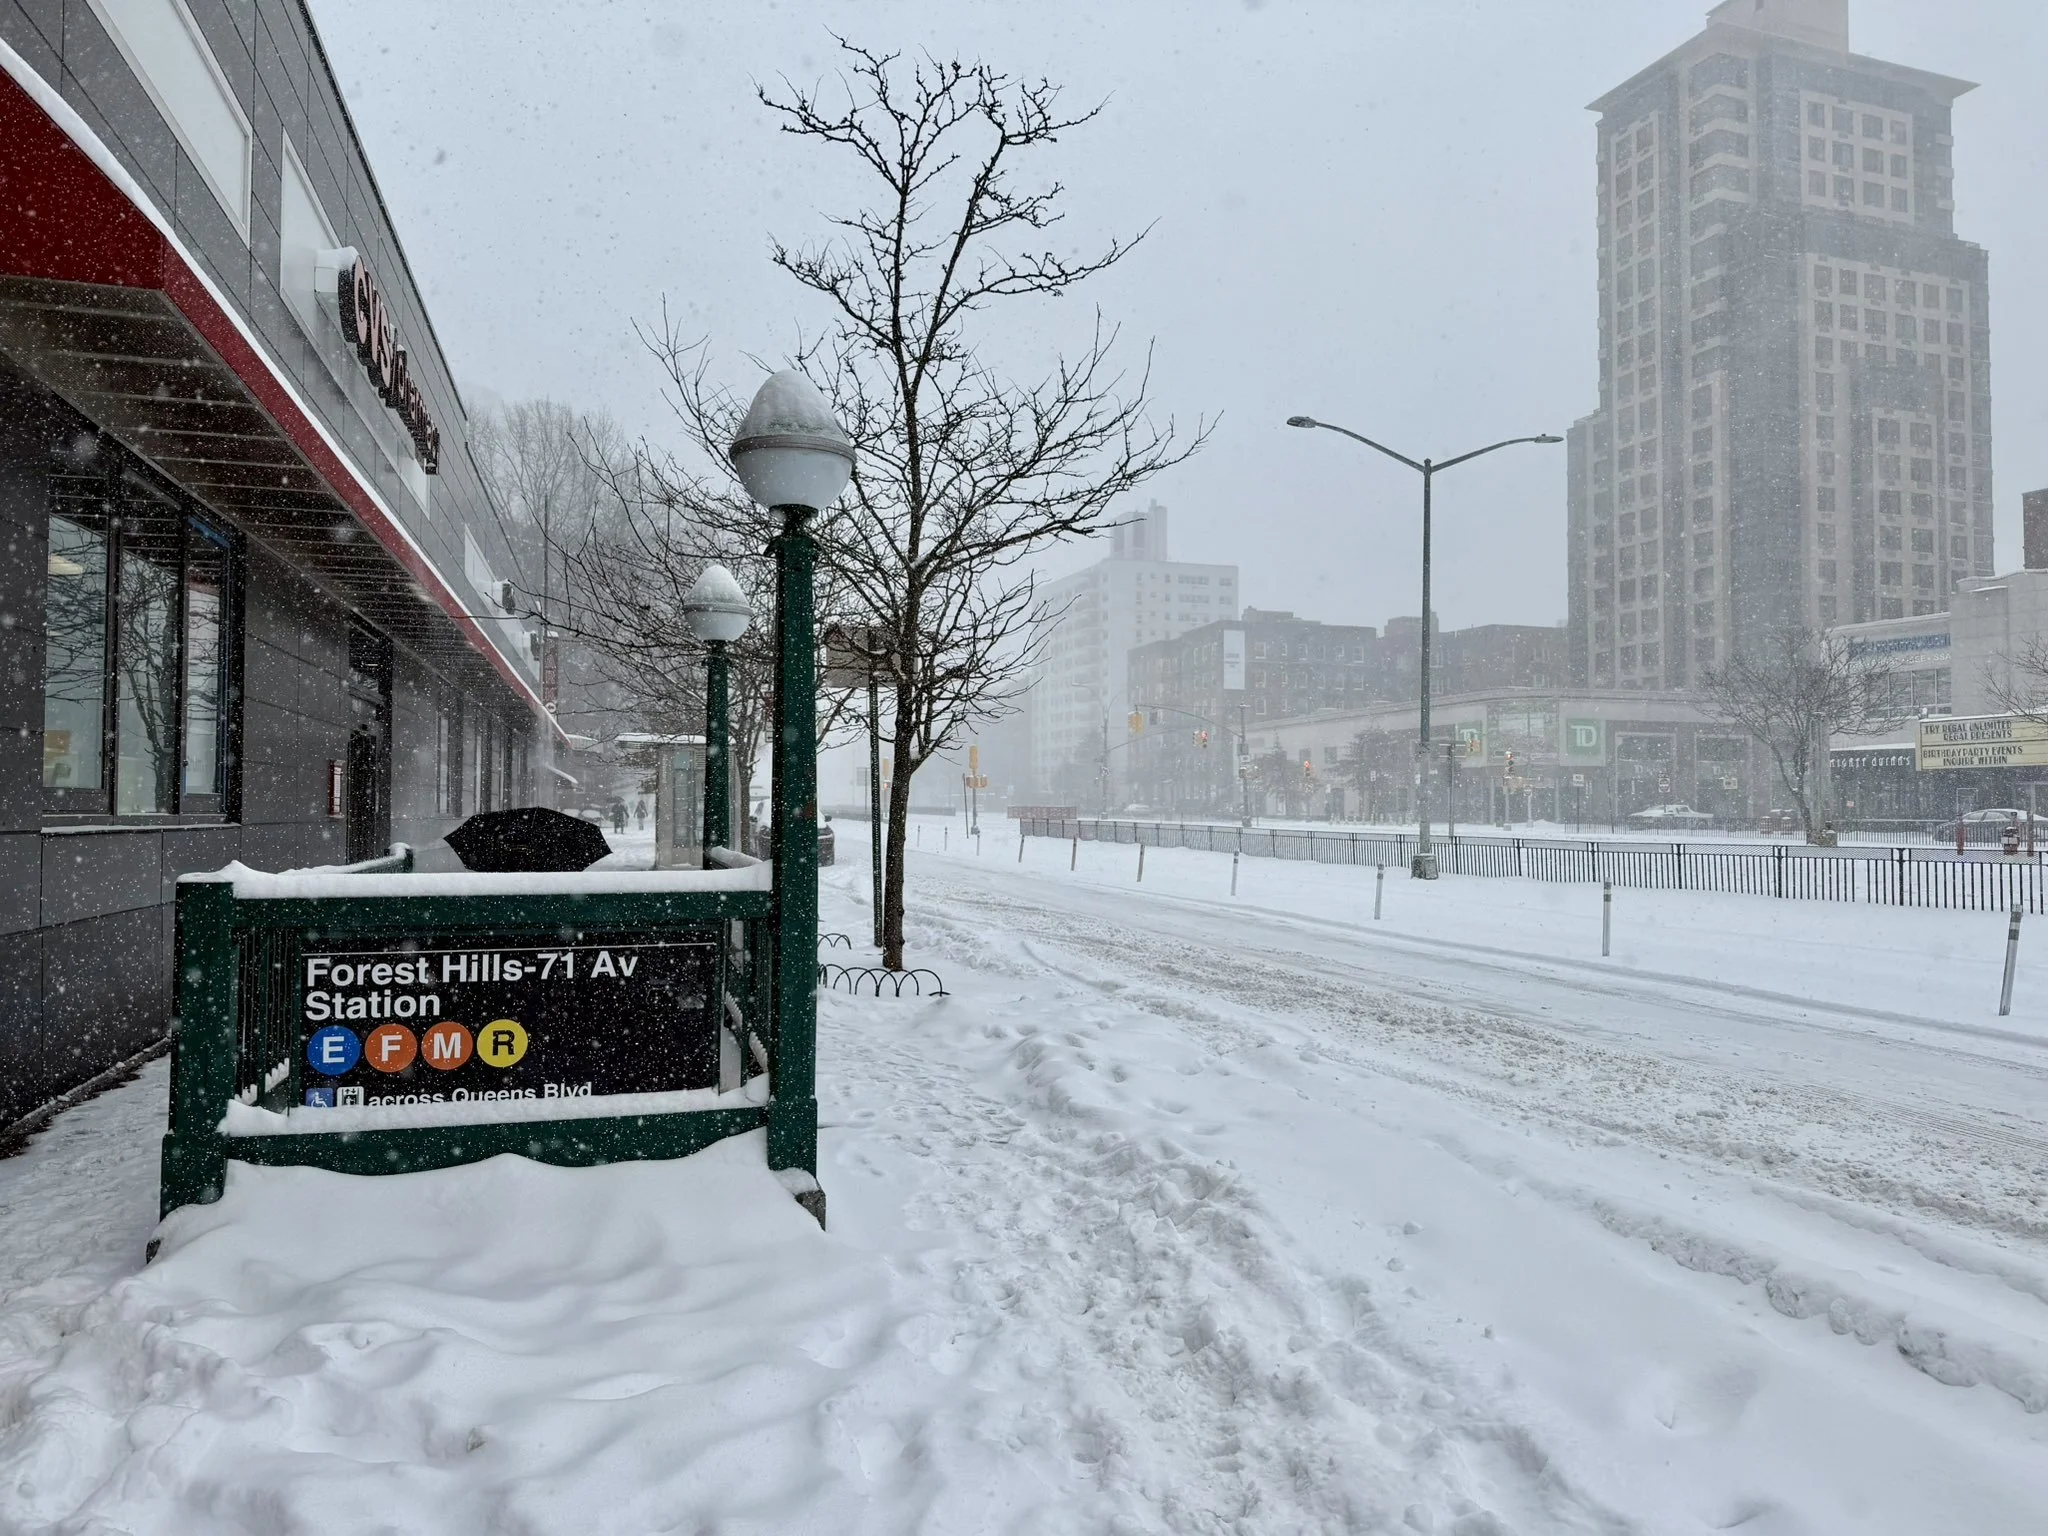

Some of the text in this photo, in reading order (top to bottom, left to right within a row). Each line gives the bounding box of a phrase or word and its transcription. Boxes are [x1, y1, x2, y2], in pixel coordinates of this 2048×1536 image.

[1571, 725, 1597, 747] TD
[1924, 720, 2012, 735] TRY REGAL UNLIMITED
[1943, 730, 2013, 742] REGAL PRESENTS
[1923, 745, 2023, 758] BIRTHDAY PARTY EVENTS
[1943, 755, 2008, 766] INQUIRE WITHIN
[307, 951, 639, 988] Forest Hills-71 Av
[306, 991, 440, 1021] Station
[323, 1030, 515, 1063] E F M R
[368, 1081, 592, 1107] across Queens Blvd
